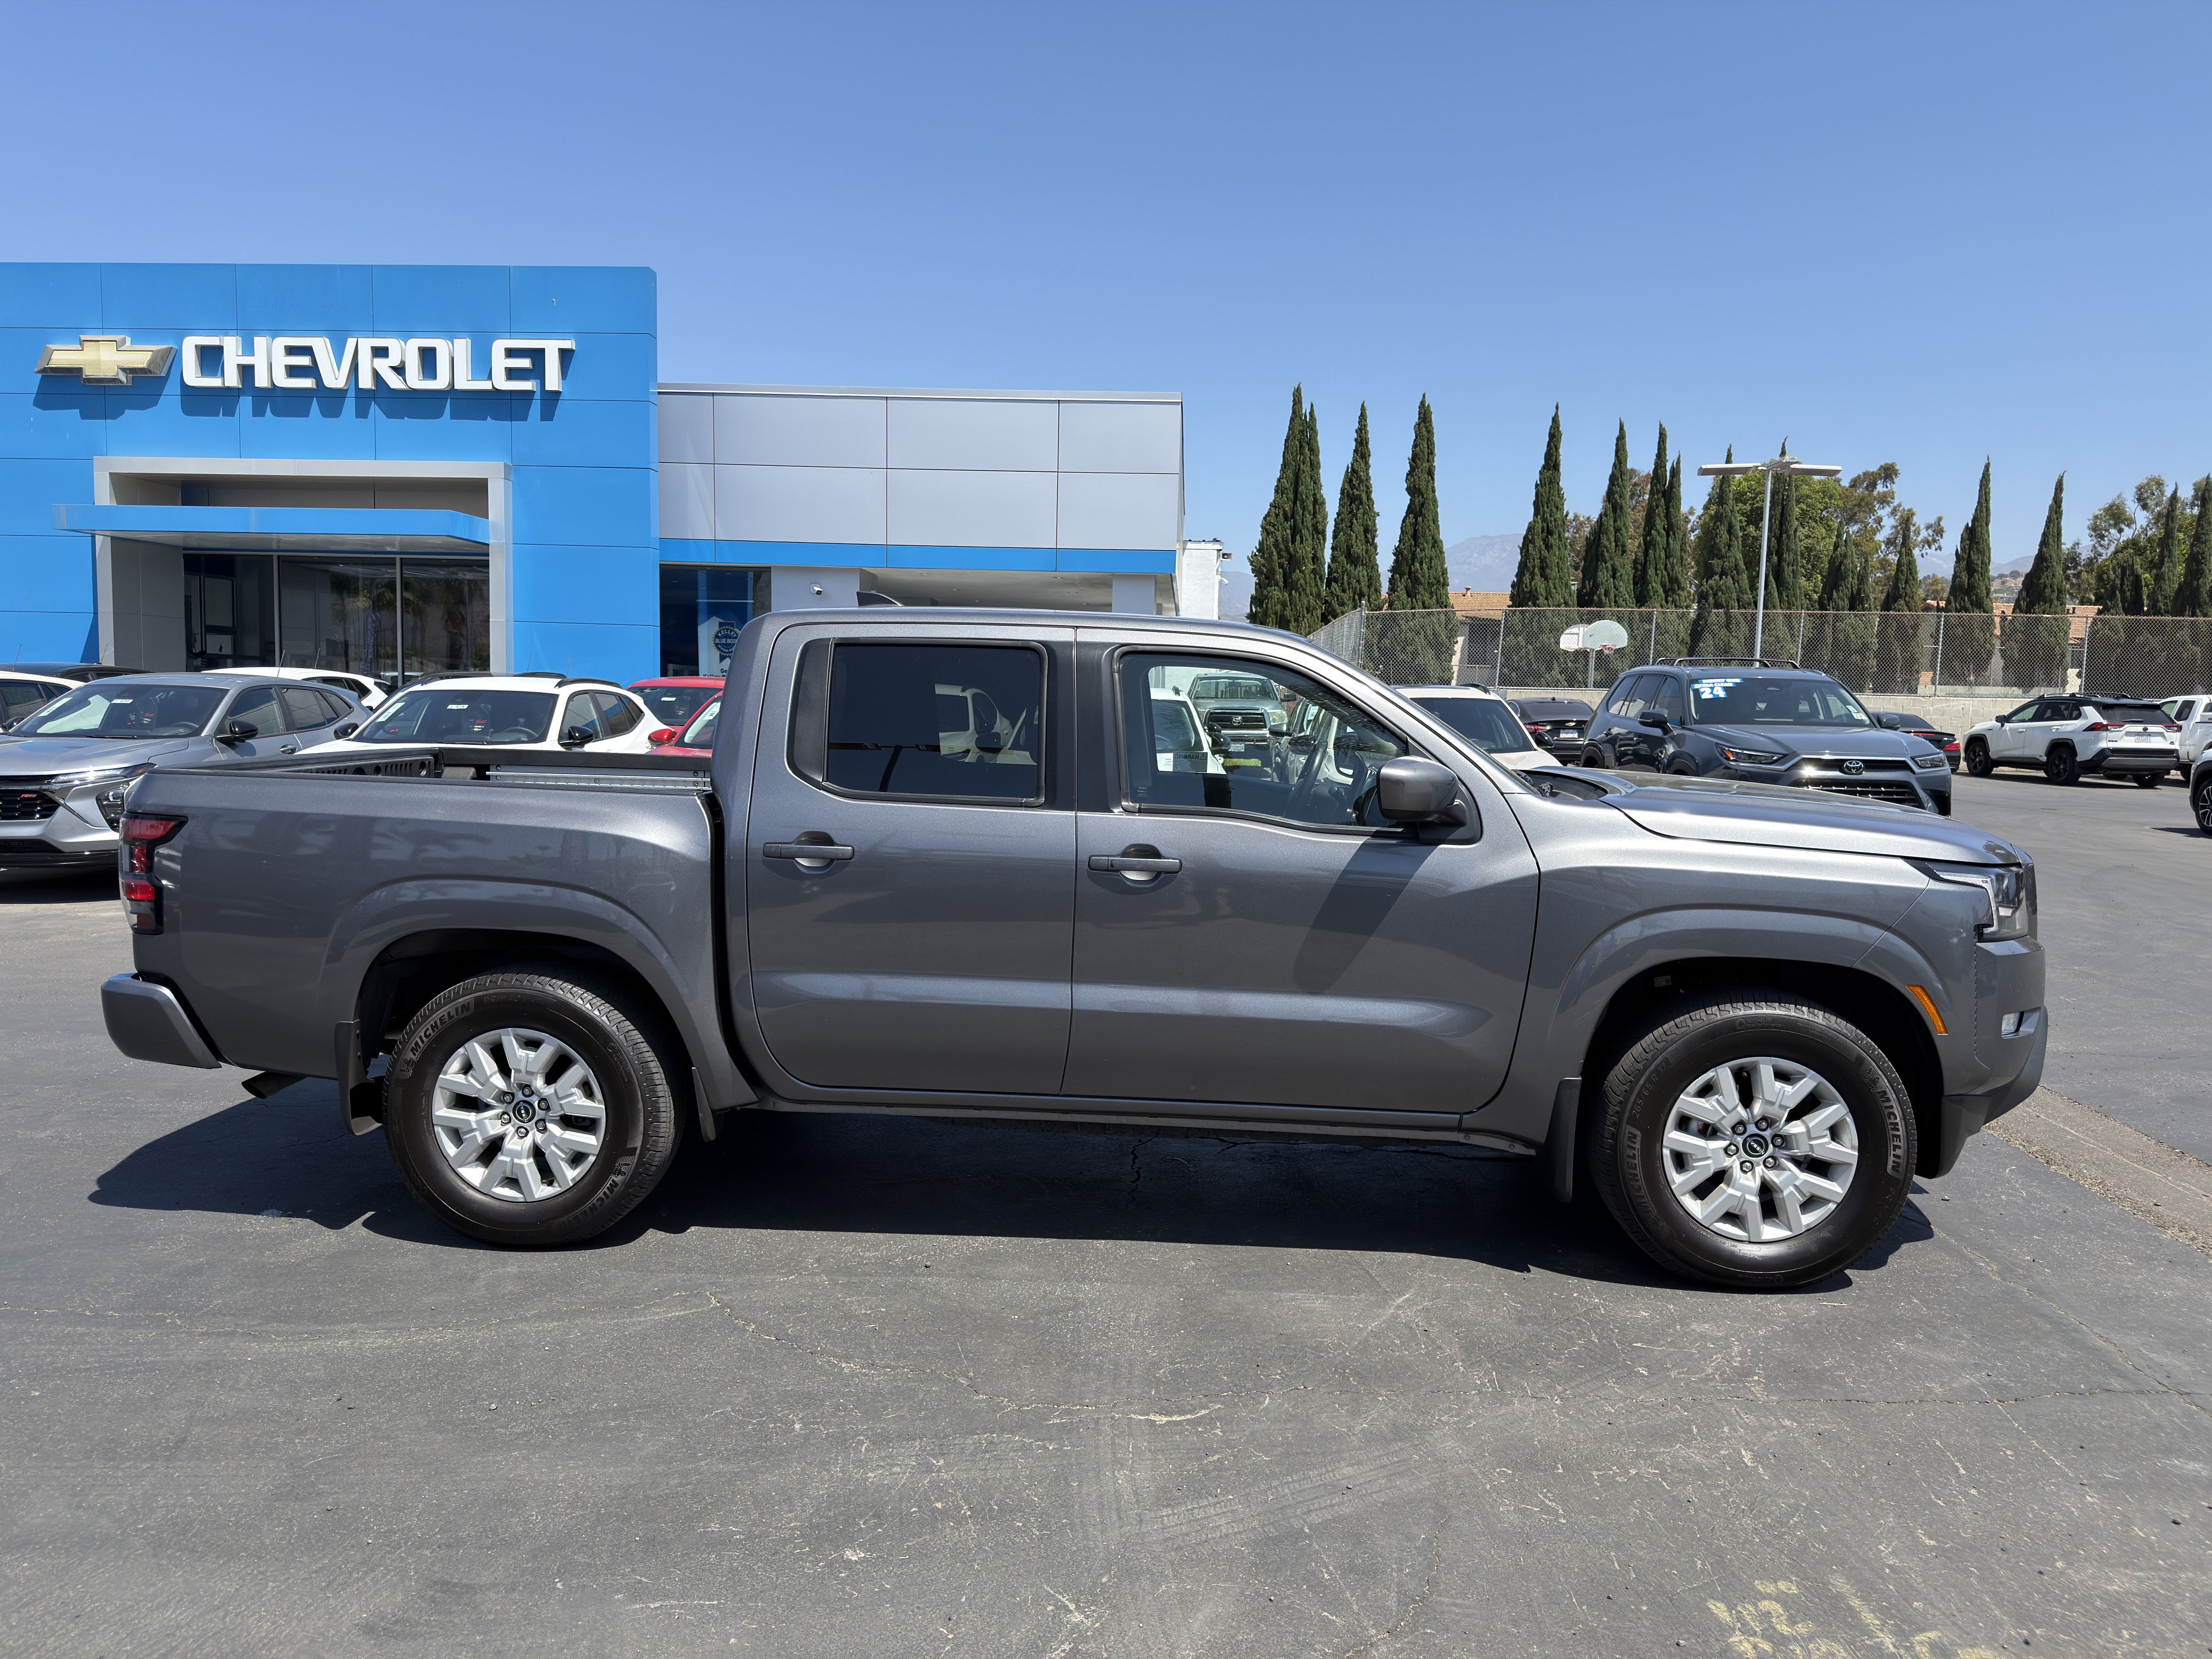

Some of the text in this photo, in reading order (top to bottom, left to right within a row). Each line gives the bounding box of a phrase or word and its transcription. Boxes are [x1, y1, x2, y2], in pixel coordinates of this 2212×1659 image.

[182, 335, 575, 392] CHEVROLET
[1700, 686, 1726, 699] 24
[410, 1001, 471, 1057] MICHELIN
[519, 1101, 528, 1122] NISSAN
[1632, 1081, 1652, 1119] 265/65
[1651, 1073, 1658, 1082] R
[1746, 1137, 1765, 1155] NISSAN
[1876, 1088, 1902, 1173] MICHELIN
